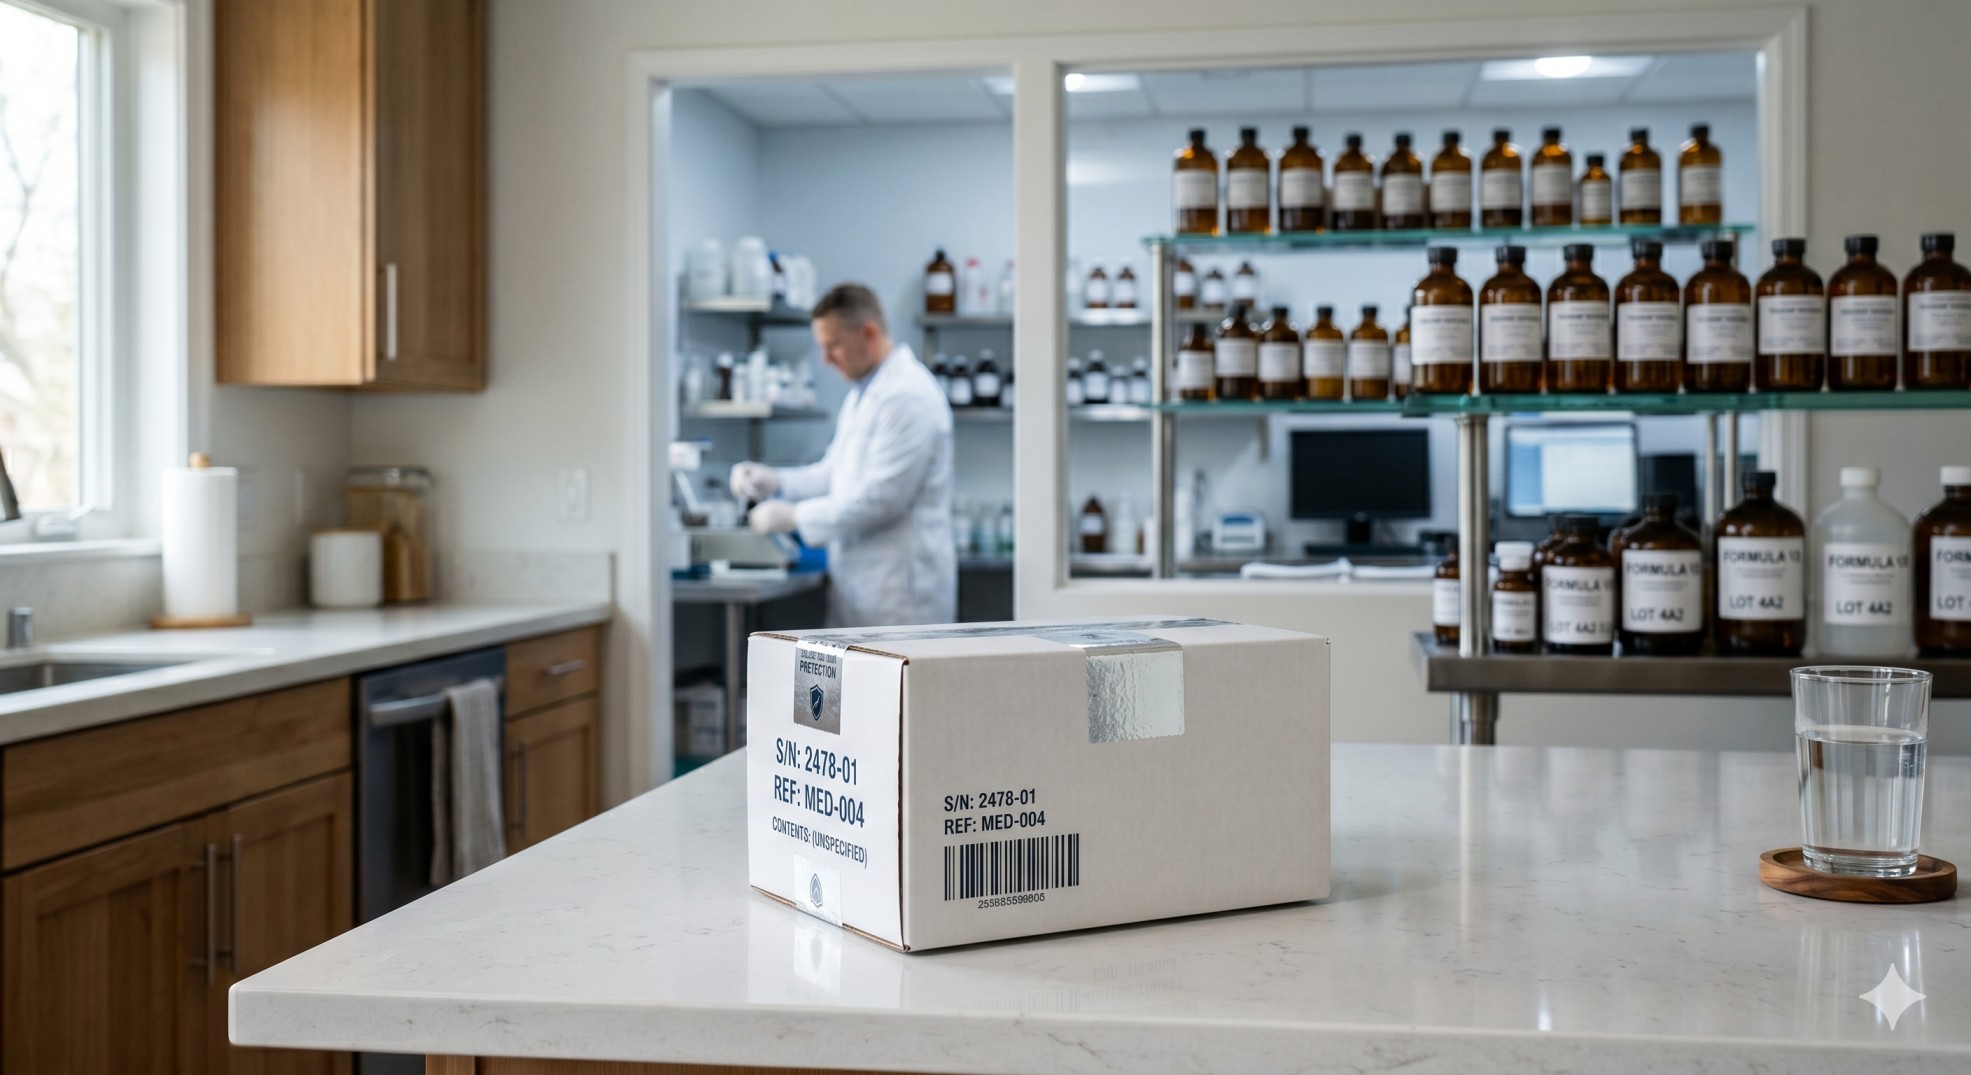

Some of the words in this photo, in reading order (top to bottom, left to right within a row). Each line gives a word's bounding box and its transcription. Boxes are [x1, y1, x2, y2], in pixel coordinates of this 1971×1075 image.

[1724, 550, 1785, 563] FORMULA
[1828, 554, 1894, 569] FORMULA
[1626, 562, 1687, 576] FORMULA
[1729, 596, 1753, 609] LOT
[1836, 601, 1863, 615] LOT
[1937, 596, 1965, 610] LOT
[1631, 609, 1654, 621] LOT
[800, 660, 836, 679] PRETECTION
[776, 738, 800, 769] S/N:
[805, 746, 857, 786] 2478-01
[774, 774, 800, 807] REF:
[805, 784, 865, 828] MED-004
[944, 794, 974, 812] S/N:
[979, 788, 1035, 809] 2478-01
[944, 817, 976, 835] REF:
[981, 811, 1046, 831] MED-004
[772, 816, 811, 844] CONTENTS:
[812, 830, 868, 869] (UNSPECIFIED)
